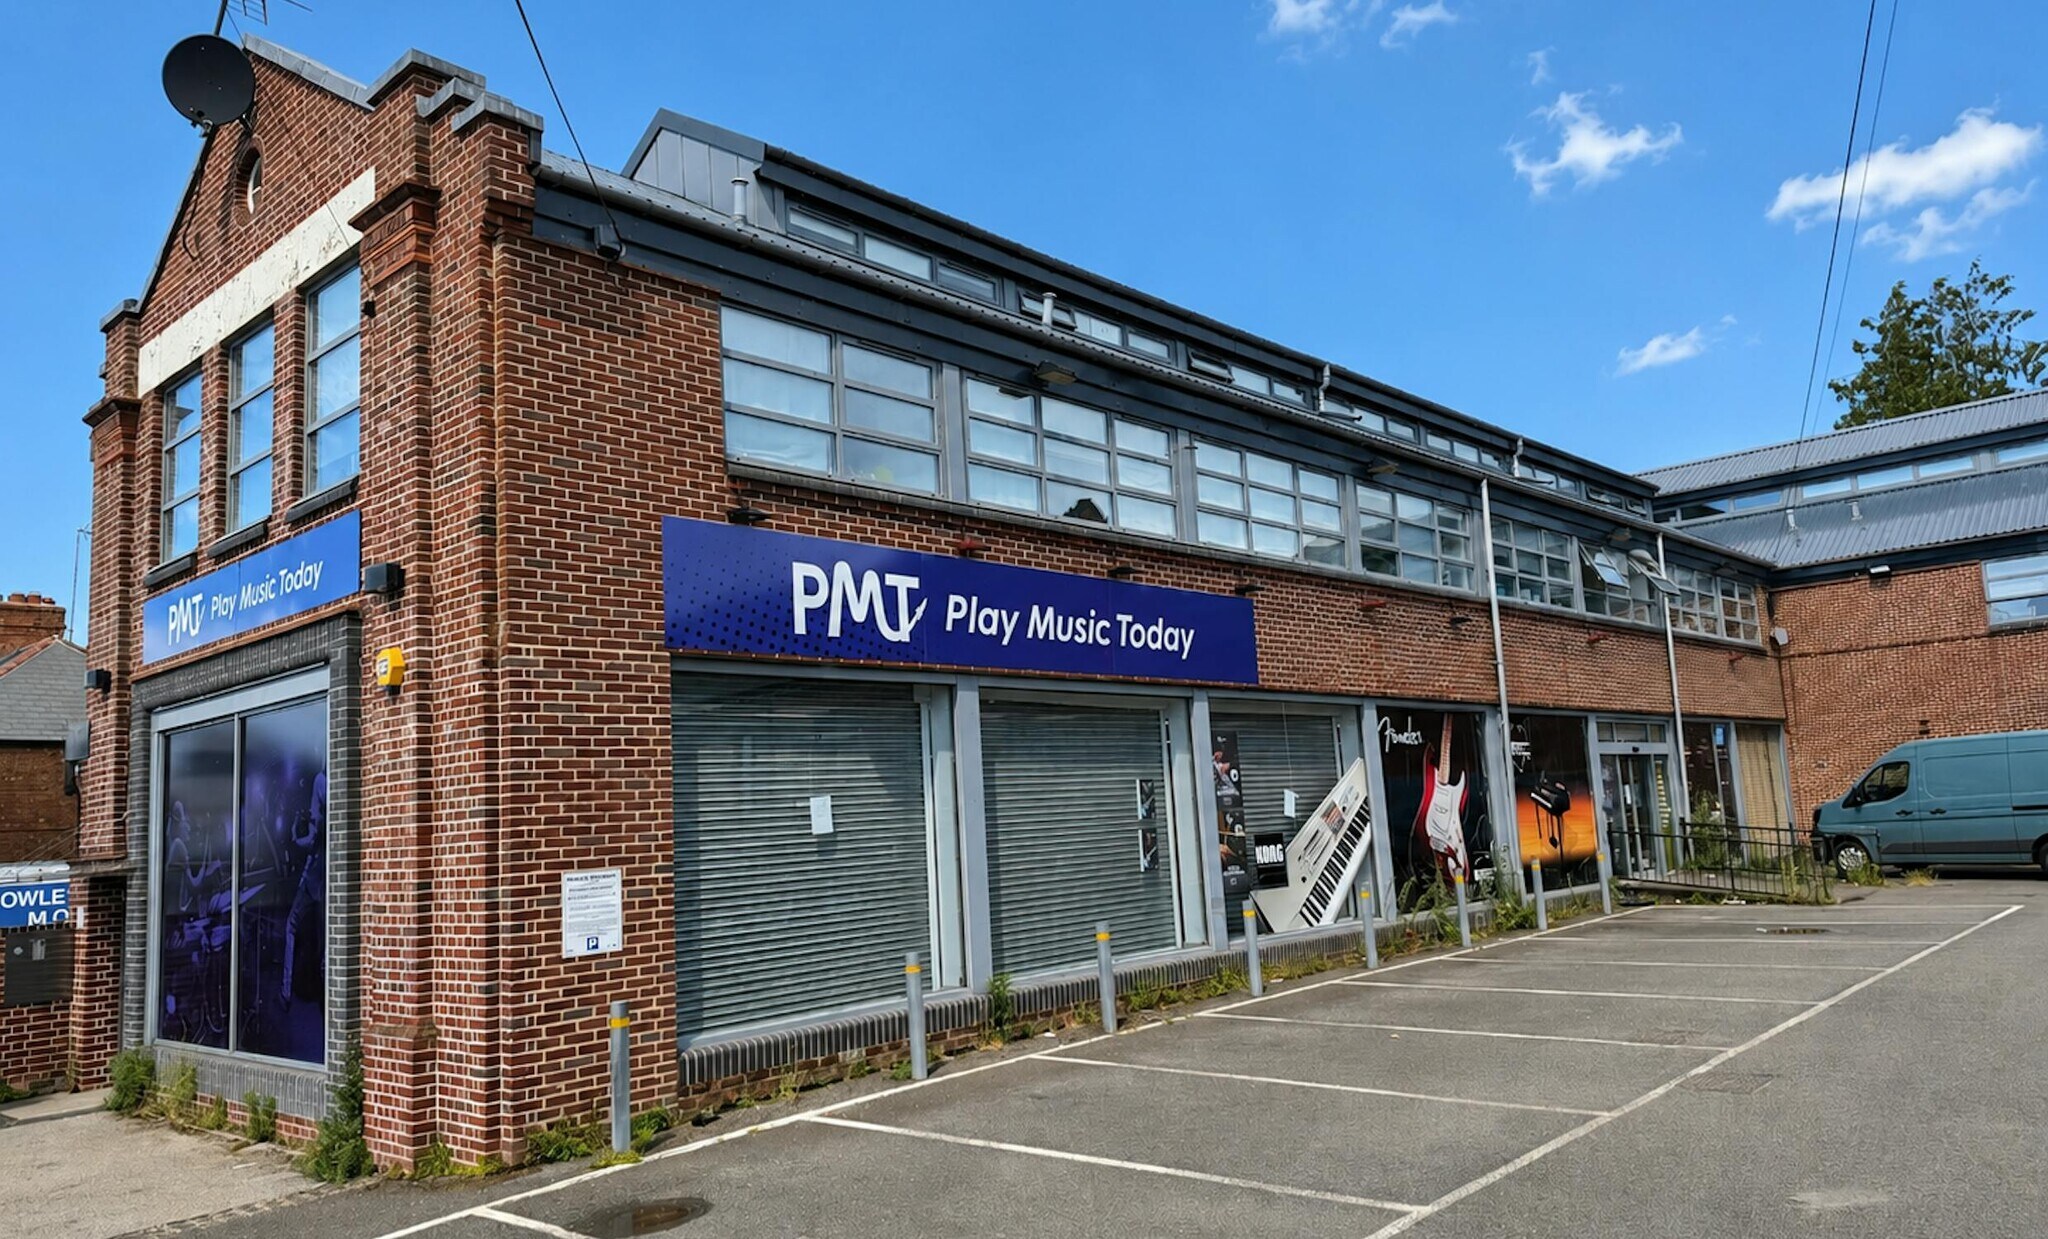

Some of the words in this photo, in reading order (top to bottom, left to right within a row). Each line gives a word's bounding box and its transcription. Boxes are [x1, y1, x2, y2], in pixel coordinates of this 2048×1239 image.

[168, 592, 206, 646] PMT
[210, 593, 237, 621] Play
[239, 574, 276, 611] Music
[279, 560, 323, 595] Today
[793, 560, 928, 643] PMT
[945, 594, 1020, 647] Play
[1026, 604, 1111, 647] Music
[1116, 613, 1195, 660] Today
[1255, 843, 1284, 864] KORG
[0, 888, 70, 909] OWLE
